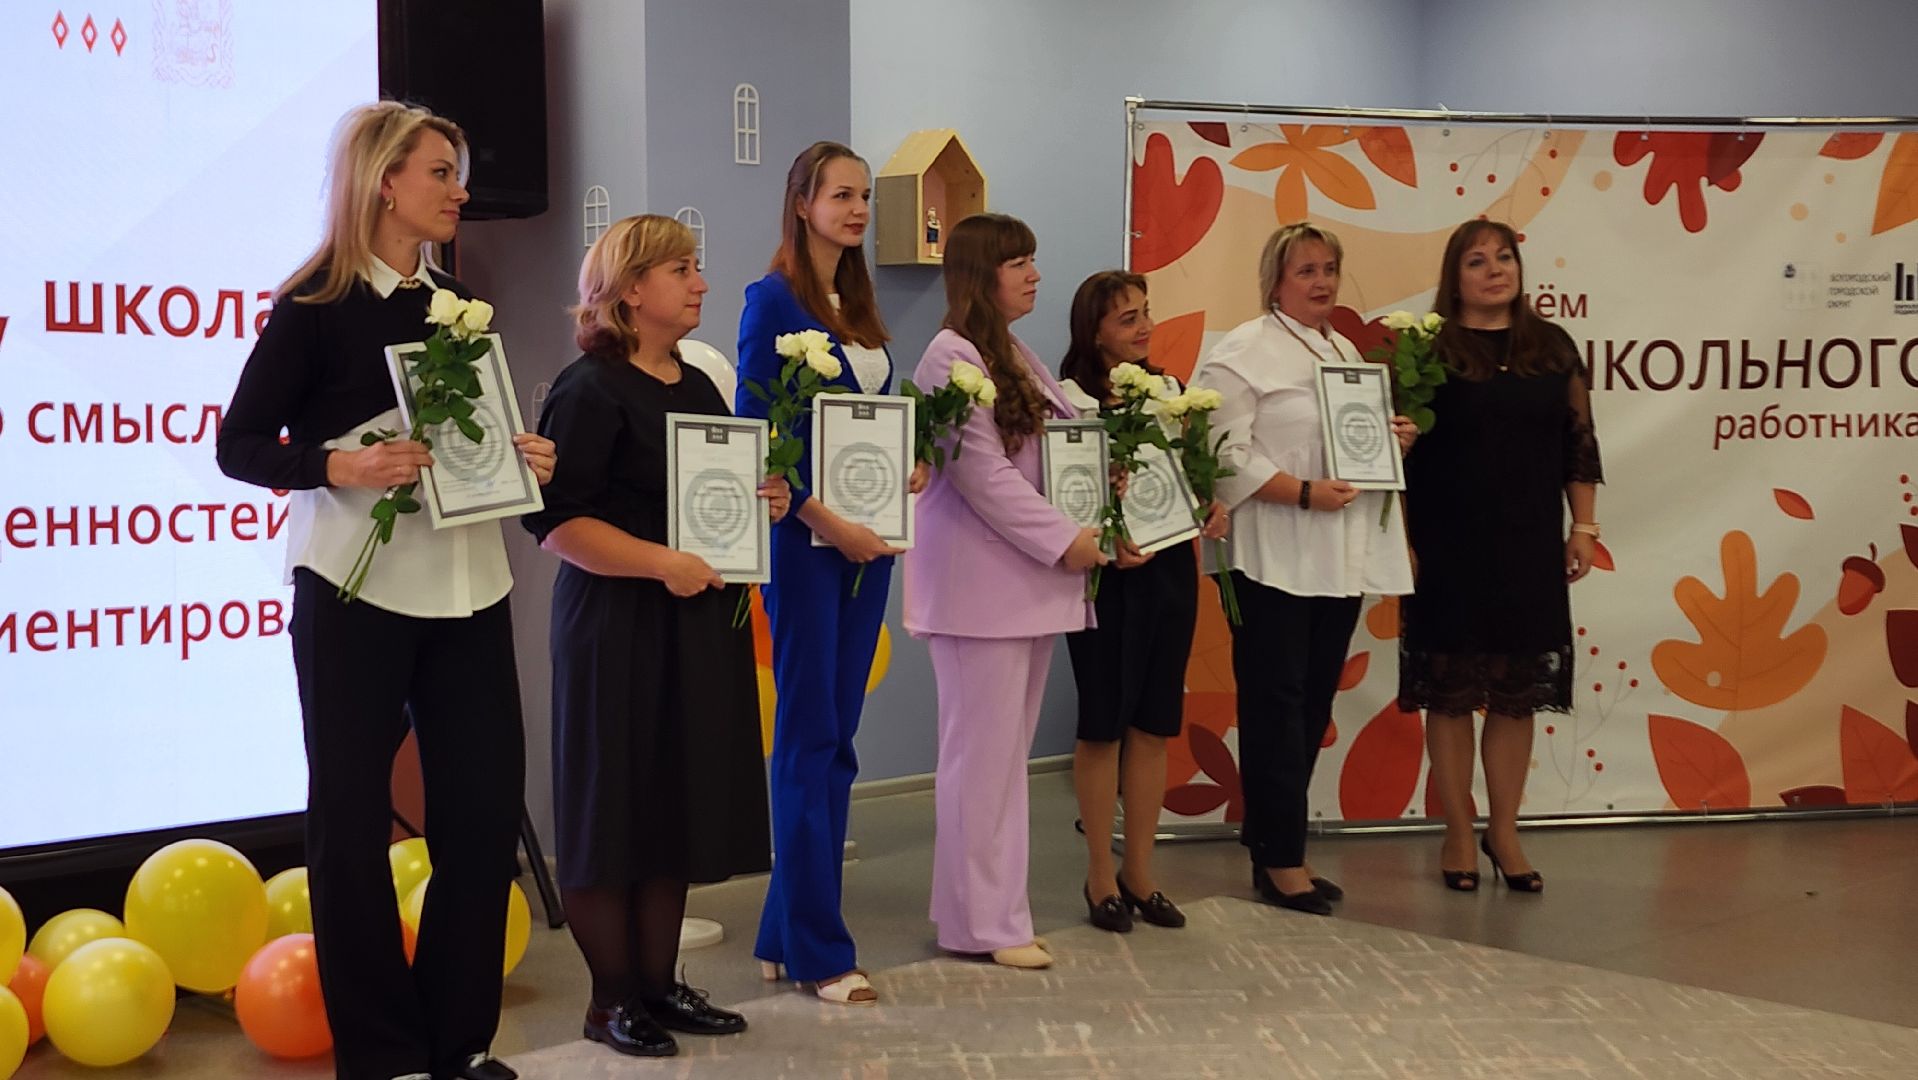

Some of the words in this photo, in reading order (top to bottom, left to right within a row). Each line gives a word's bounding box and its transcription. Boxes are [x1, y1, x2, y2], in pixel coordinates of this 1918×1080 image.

[1525, 284, 1587, 318] ём
[1586, 338, 1918, 390] КОЛЬНОГ
[1713, 404, 1918, 450] работника
[0, 488, 290, 549] енностей
